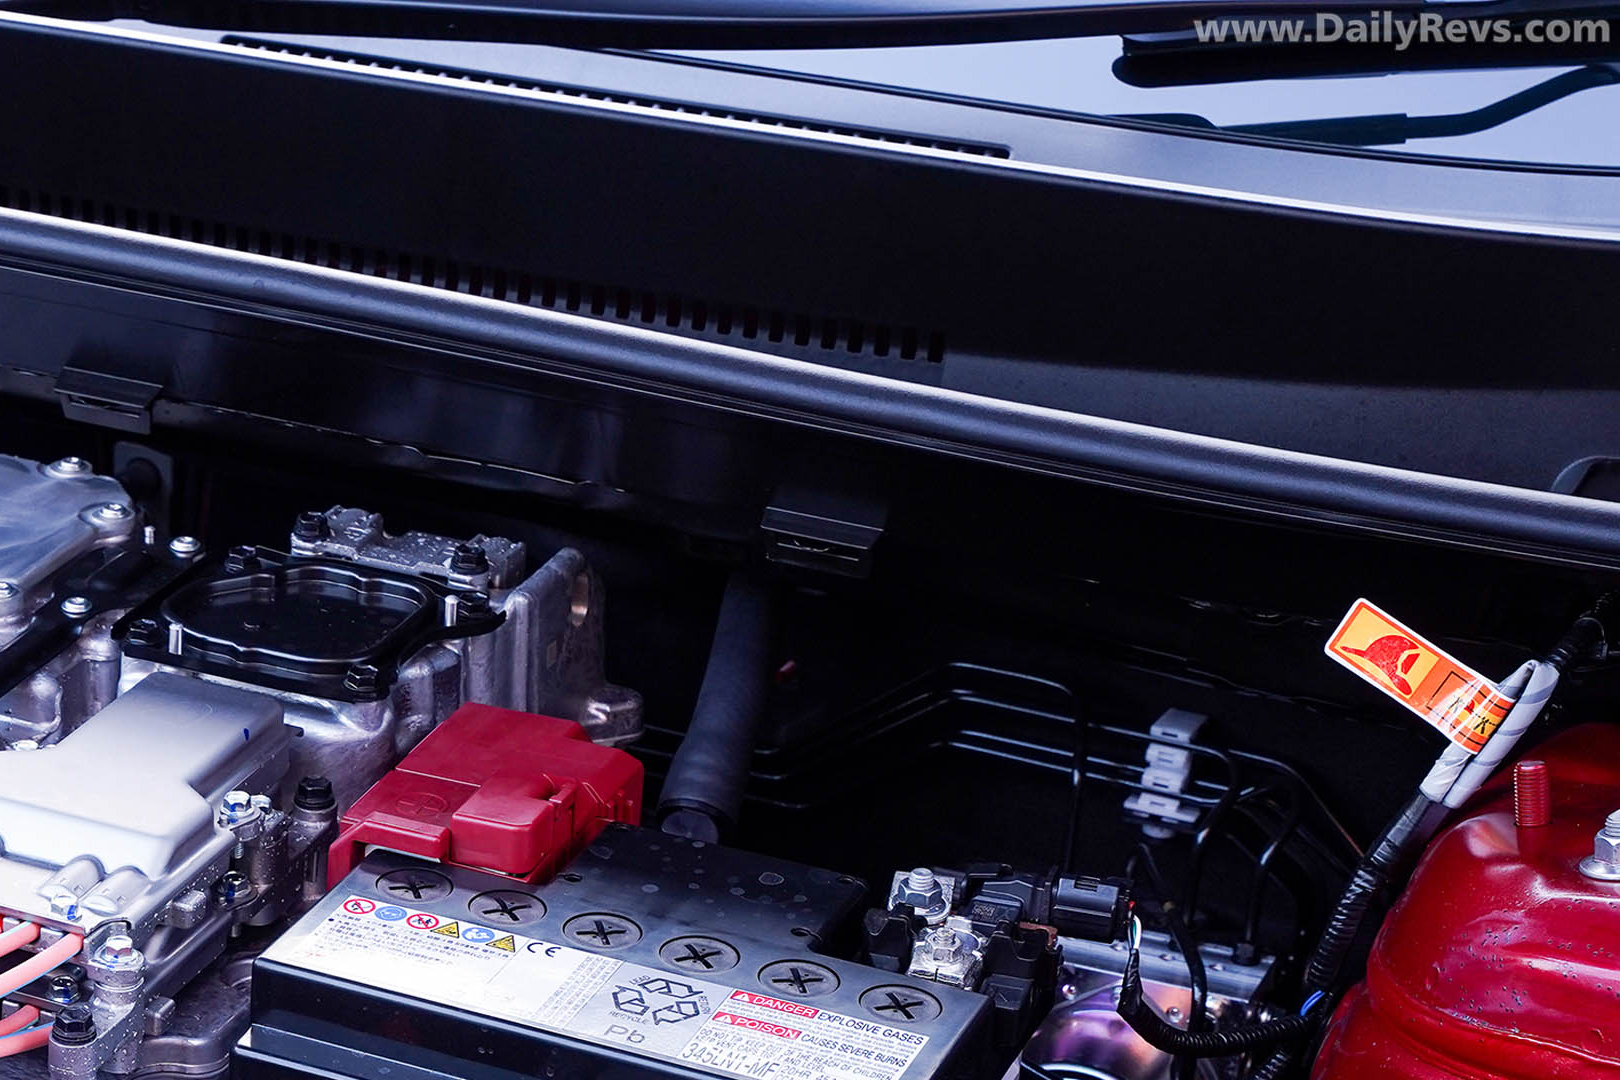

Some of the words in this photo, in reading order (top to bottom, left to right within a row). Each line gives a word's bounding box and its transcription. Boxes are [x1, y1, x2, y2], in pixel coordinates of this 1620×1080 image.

[604, 1024, 646, 1044] Pb
[753, 996, 815, 1017] DANGER
[818, 1012, 882, 1034] EXPLOSIVE
[882, 1029, 924, 1045] GASES
[682, 1042, 780, 1078] 345LN1-MF
[735, 1018, 798, 1039] POISON
[801, 1033, 838, 1049] CAUSES
[838, 1043, 875, 1059] SEVERE
[875, 1053, 908, 1067] BURNS
